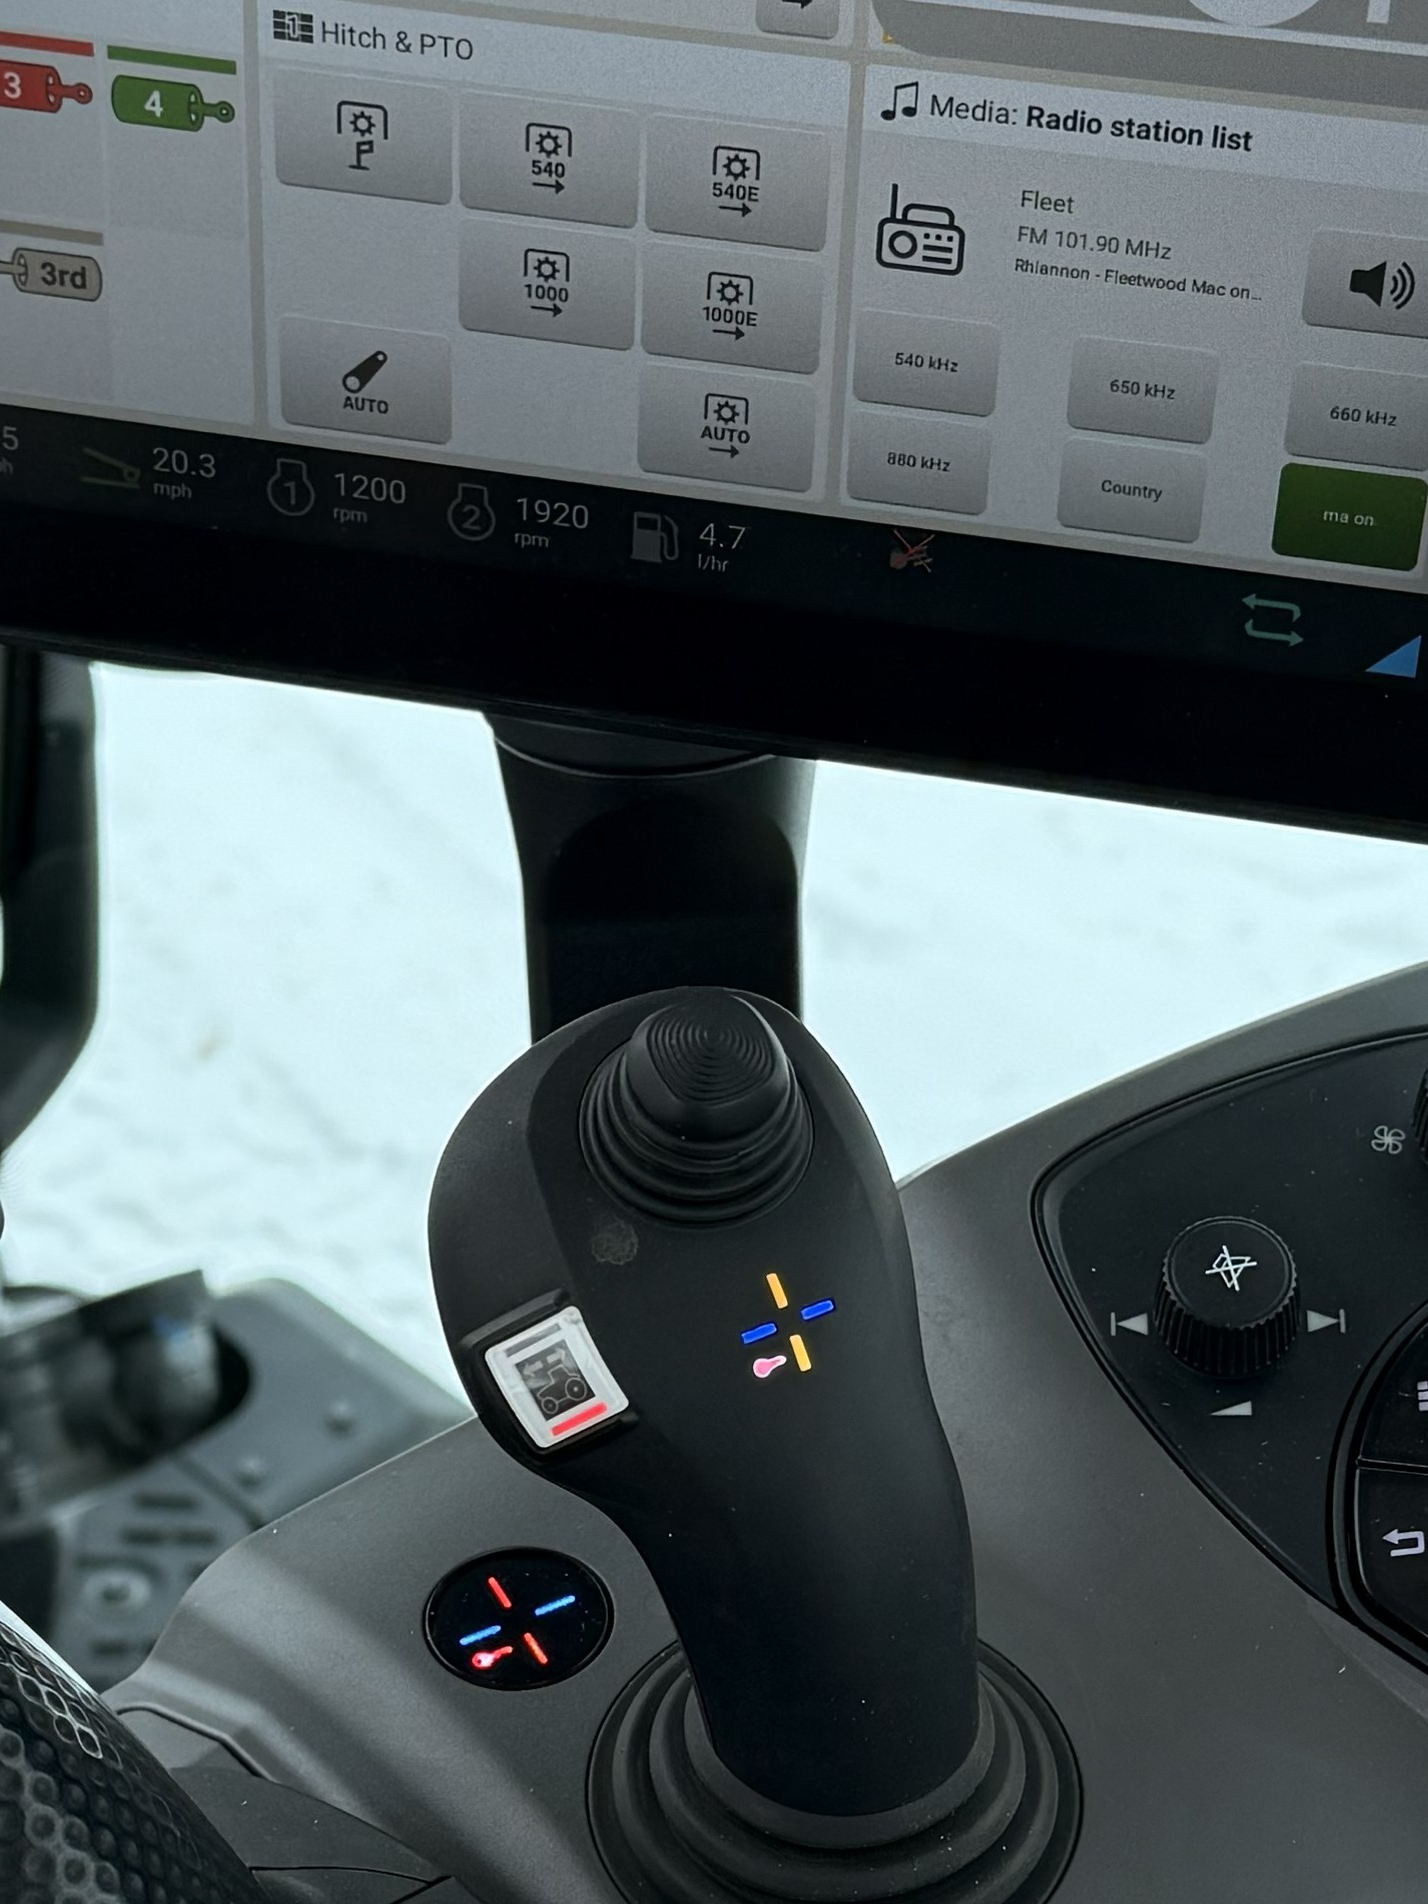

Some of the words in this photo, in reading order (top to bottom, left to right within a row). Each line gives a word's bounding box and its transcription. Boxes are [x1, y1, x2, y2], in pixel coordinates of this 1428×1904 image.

[322, 21, 386, 50] Hitch
[395, 31, 412, 53] &
[420, 33, 474, 60] PTO
[3, 72, 21, 100] 3
[143, 89, 164, 118] 4
[930, 94, 1018, 126] Media:
[1026, 105, 1103, 135] Radio
[1110, 117, 1204, 147] station
[1211, 125, 1253, 151] list
[532, 160, 565, 178] 540
[712, 181, 760, 203] 540E
[1021, 190, 1075, 214] Fleet
[1018, 226, 1048, 245] FM
[1055, 231, 1119, 254] 101.90
[1125, 239, 1172, 260] MHz
[40, 260, 88, 289] 3rd
[1014, 258, 1090, 281] Rhiannon
[1104, 270, 1186, 292] Fleetwood
[1192, 279, 1226, 297] Mac
[524, 284, 569, 303] 1000
[703, 306, 758, 328] 1000E
[894, 352, 924, 368] 540
[928, 356, 958, 372] kHz
[1110, 379, 1140, 396] 650
[1145, 383, 1175, 400] kHz
[343, 396, 389, 415] AUTO
[1330, 406, 1361, 423] 660
[1366, 409, 1397, 426] kHz
[700, 425, 751, 444] AUTO
[153, 447, 217, 479] 20.3
[887, 452, 916, 467] 880
[921, 455, 950, 472] kHz
[154, 481, 192, 500] mph
[333, 472, 406, 504] 1200
[1101, 479, 1163, 502] Country
[332, 506, 368, 525] rpm
[515, 497, 590, 529] 1920
[514, 531, 550, 550] rpm
[699, 522, 747, 551] 4.7
